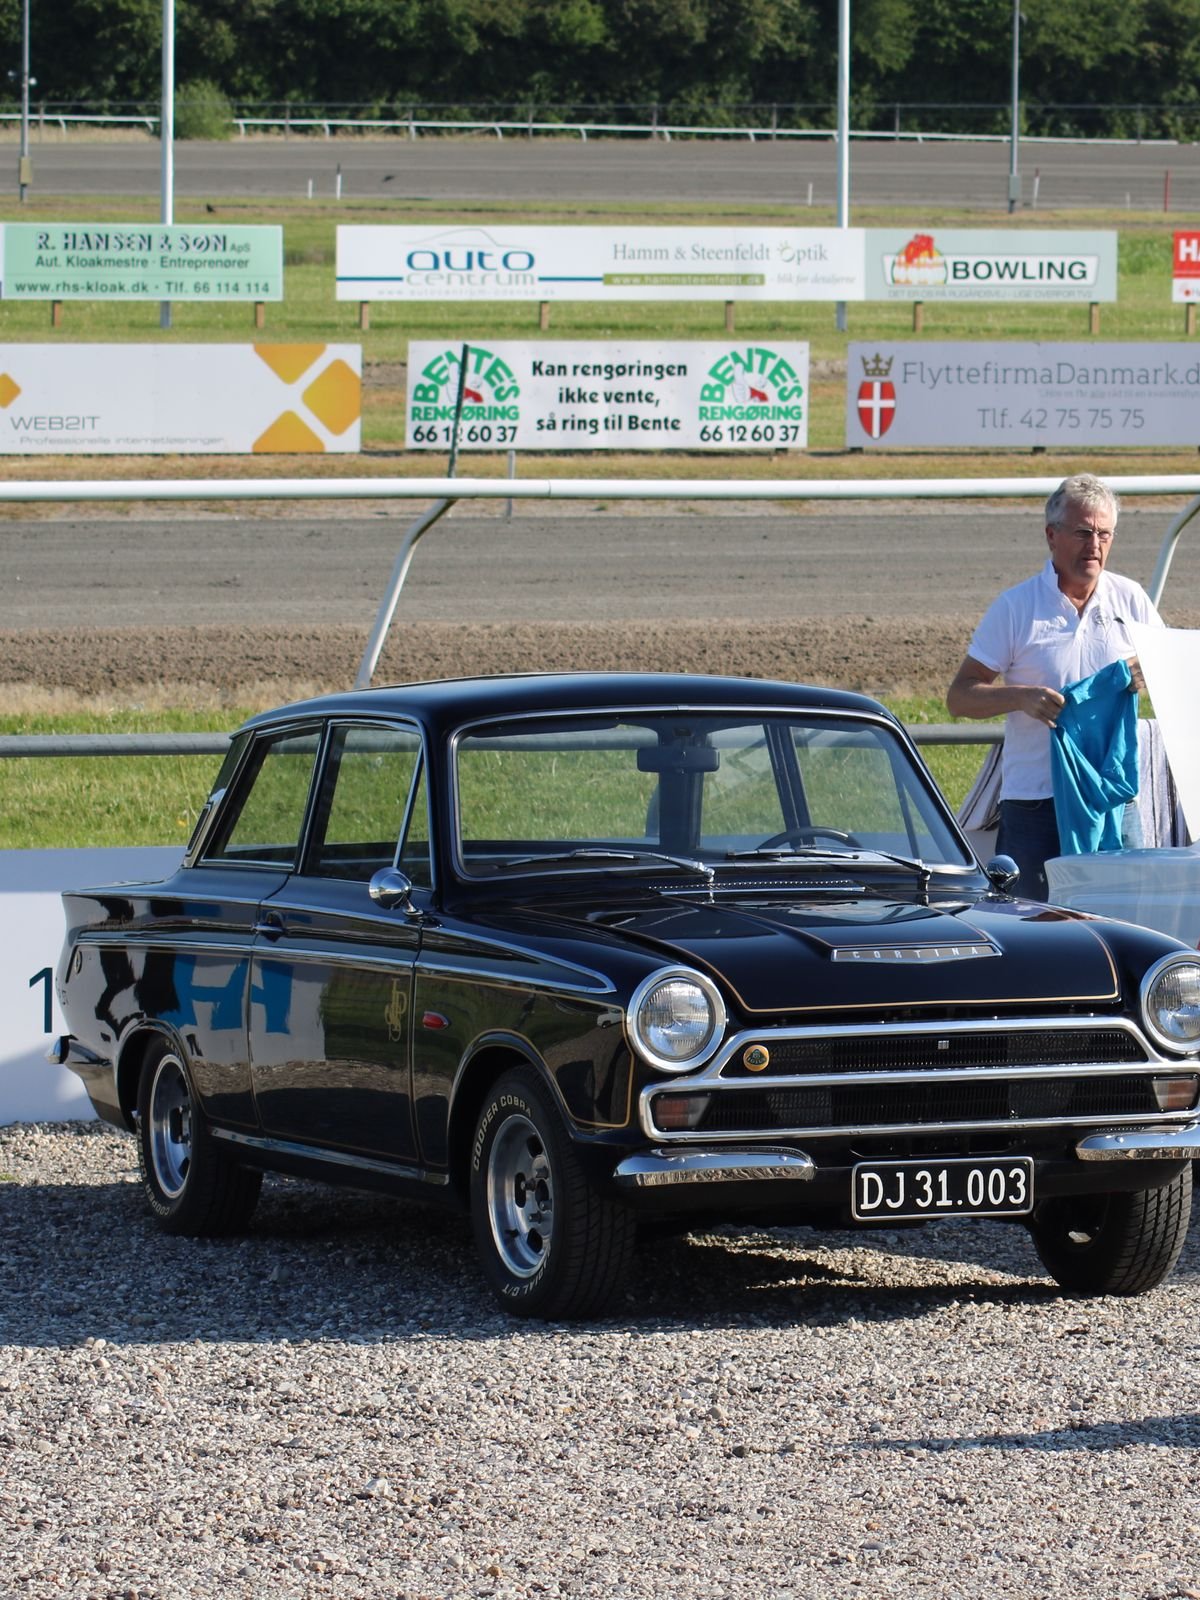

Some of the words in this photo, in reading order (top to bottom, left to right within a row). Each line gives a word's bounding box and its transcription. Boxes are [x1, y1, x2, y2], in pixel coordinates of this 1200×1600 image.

[37, 233, 57, 250] R.
[64, 233, 151, 251] HANSEN
[180, 233, 228, 252] SØN
[36, 255, 62, 268] Aut.
[66, 255, 148, 268] Kloakmestre
[160, 255, 250, 270] Entreprenører
[406, 250, 535, 271] auto
[613, 244, 669, 261] Hamm
[674, 245, 686, 261] &
[691, 243, 770, 261] Steenfeldt
[778, 241, 829, 265] Optik
[406, 272, 535, 287] centrum
[952, 261, 1089, 280] BOWLING
[15, 280, 149, 294] www.rhs-kloak.dk
[165, 281, 189, 293] Tlf.
[194, 281, 210, 293] 66
[217, 281, 240, 293] 114
[247, 281, 270, 293] 114
[532, 361, 567, 376] Kan
[573, 360, 687, 380] rengøringen
[700, 348, 803, 402] BENTE'S
[559, 388, 600, 403] ikke
[604, 388, 660, 407] vente,
[412, 406, 519, 421] RENGØRING
[699, 405, 802, 421] RENGØRING
[978, 408, 1013, 428] Tlf.
[1020, 409, 1048, 428] 42
[1056, 409, 1081, 428] 75
[1088, 409, 1113, 428] 75
[1120, 409, 1145, 428] 75
[11, 417, 100, 430] WEB2IT
[537, 412, 556, 430] så
[562, 415, 599, 434] ring
[604, 415, 623, 430] til
[628, 416, 681, 430] Bente
[413, 426, 438, 442] 66
[467, 426, 492, 442] 60
[497, 426, 518, 442] 37
[700, 425, 723, 441] 66
[729, 425, 747, 441] 12
[751, 425, 774, 441] 60
[779, 425, 799, 441] 37
[853, 947, 978, 959] CORTINA
[474, 1102, 499, 1171] COOPER
[500, 1094, 532, 1118] COBRA
[860, 1172, 905, 1210] DJ
[915, 1168, 1026, 1208] 31.003
